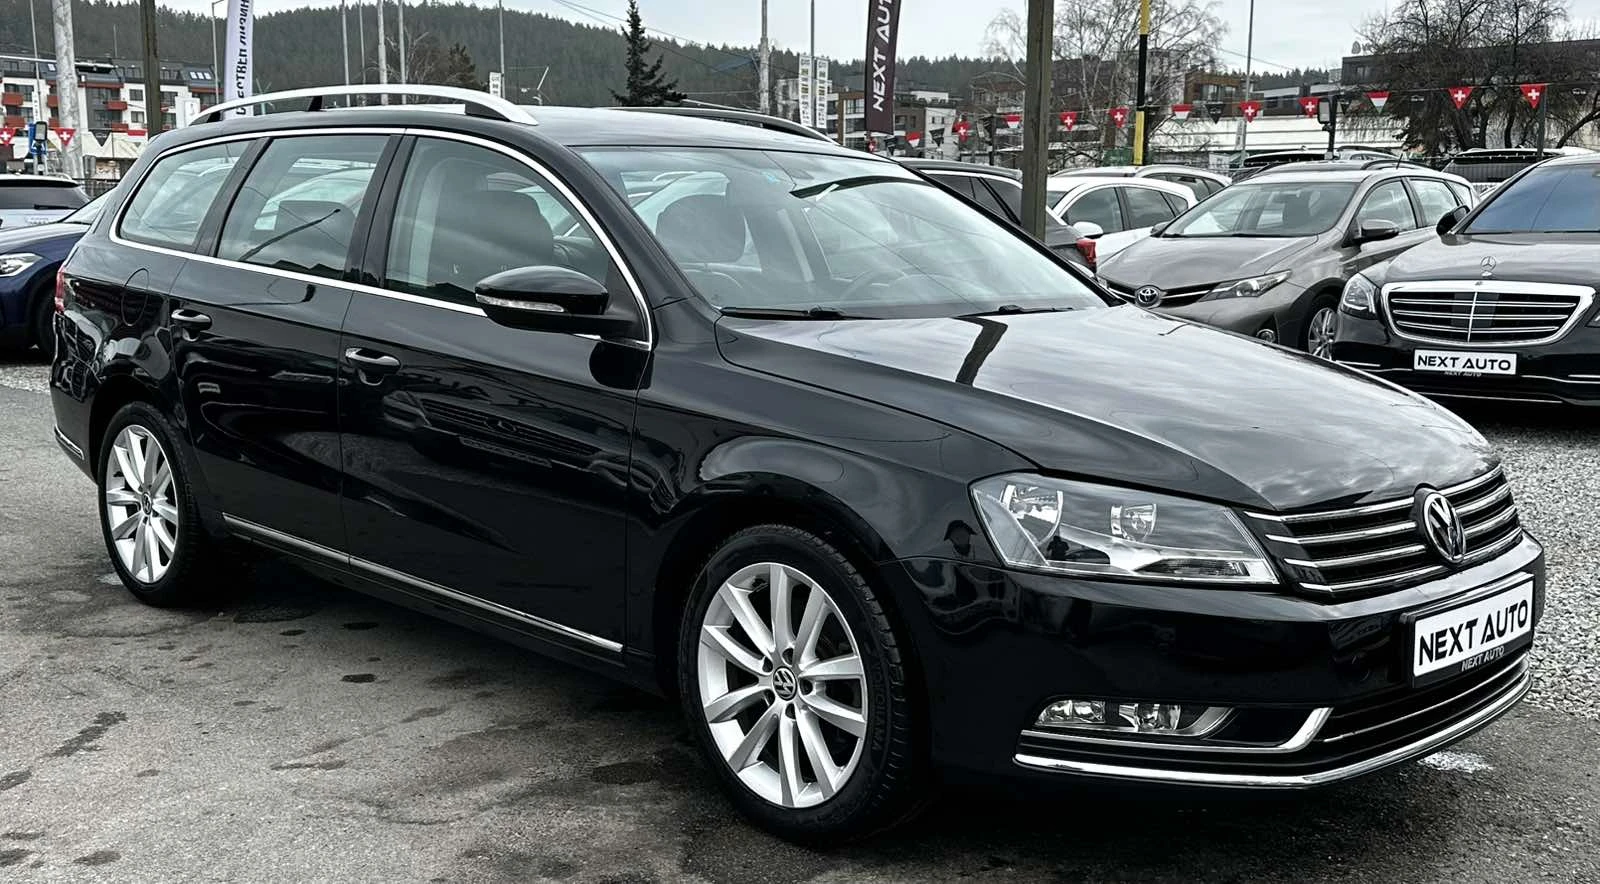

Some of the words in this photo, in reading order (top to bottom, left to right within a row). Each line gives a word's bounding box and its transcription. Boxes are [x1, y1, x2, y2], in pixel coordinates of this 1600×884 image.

[873, 46, 886, 112] NEXT
[1418, 355, 1460, 368] NEXT
[1462, 357, 1511, 371] AUTO
[1419, 617, 1479, 666] NEXT
[1480, 599, 1528, 645] AUTO
[1461, 653, 1484, 672] NEXT
[1484, 645, 1505, 663] AUTO
